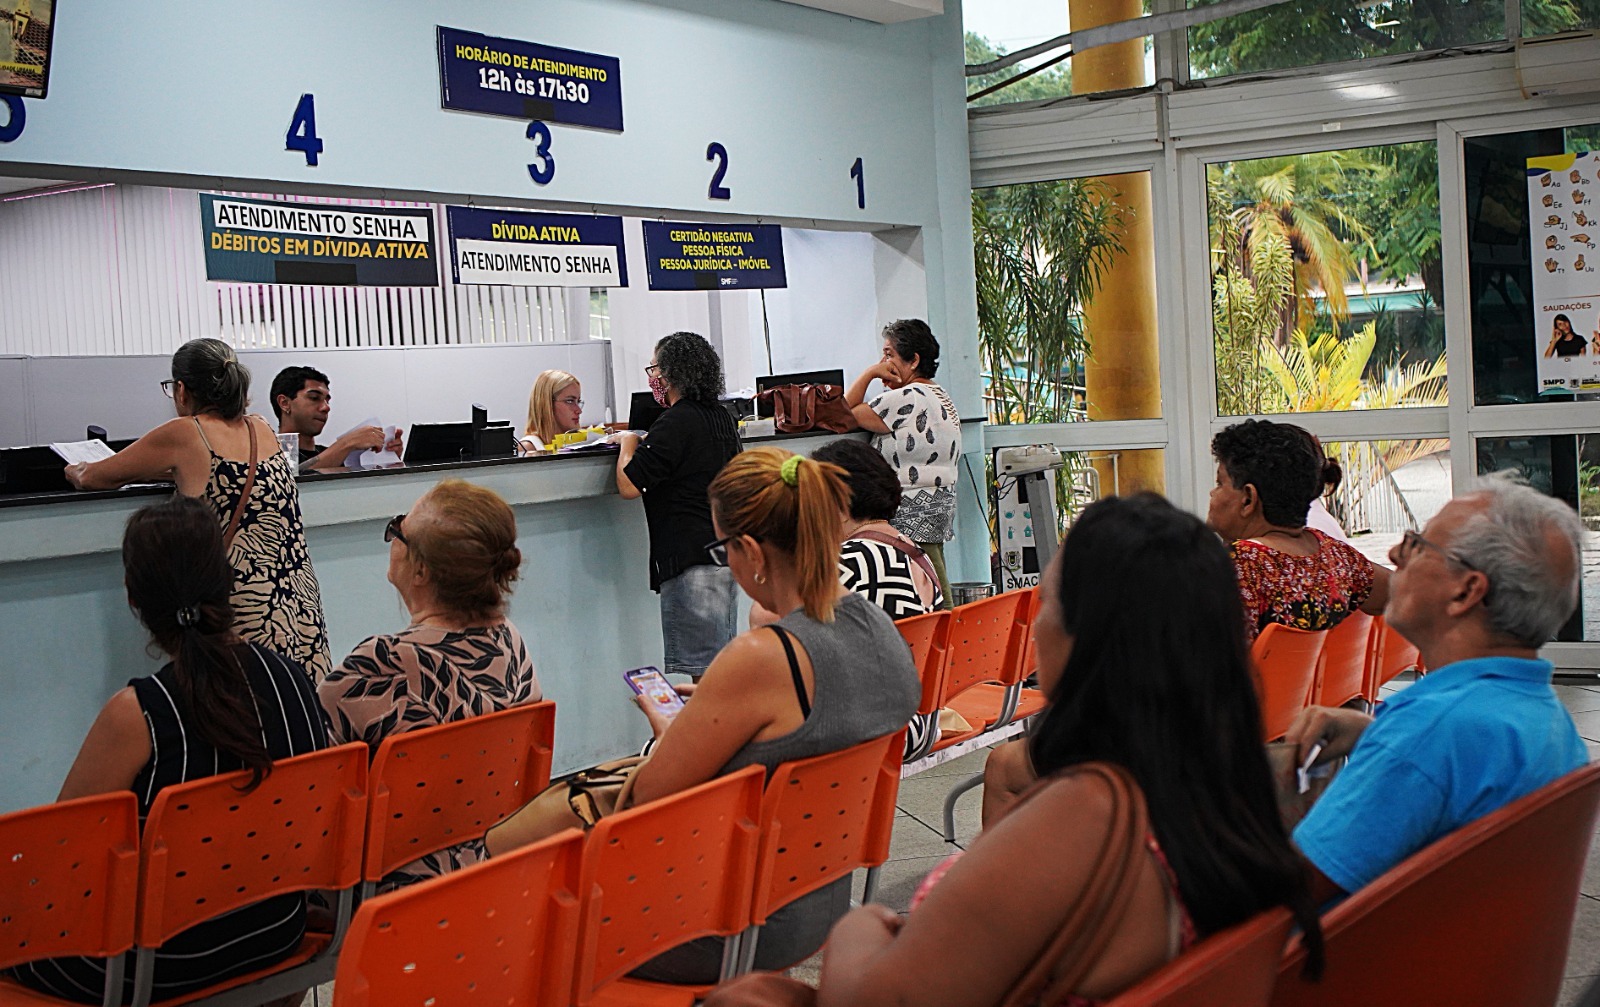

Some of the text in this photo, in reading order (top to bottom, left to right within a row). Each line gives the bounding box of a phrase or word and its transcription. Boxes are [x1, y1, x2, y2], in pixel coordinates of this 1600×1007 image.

[456, 44, 607, 82] HORÁRIO DE ATENDIMENTO
[479, 67, 589, 104] 12h às 17h30
[285, 93, 323, 167] 4
[526, 119, 555, 185] 3
[706, 142, 731, 200] 2
[850, 157, 865, 209] 1
[1553, 201, 1563, 209] Ee
[218, 204, 417, 238] ATENDIMENTO SENHA
[492, 220, 581, 242] DÍVIDA ATIVA
[211, 229, 428, 259] DÉBITOS EM DÍVIDA ATIVA
[670, 228, 754, 243] CERTIDÃO NEGATIVA
[1587, 241, 1596, 249] Pp
[682, 243, 744, 256] PESSOA FÍSICA
[461, 251, 612, 274] ATENDIMENTO SENHA
[660, 258, 692, 270] PESSOA
[693, 257, 733, 270] JURÍDICA
[738, 256, 771, 270] IMÓVEL
[1543, 302, 1592, 312] SAUDAÇÕES
[1543, 378, 1565, 386] SMPD
[1006, 575, 1038, 588] SMAC
